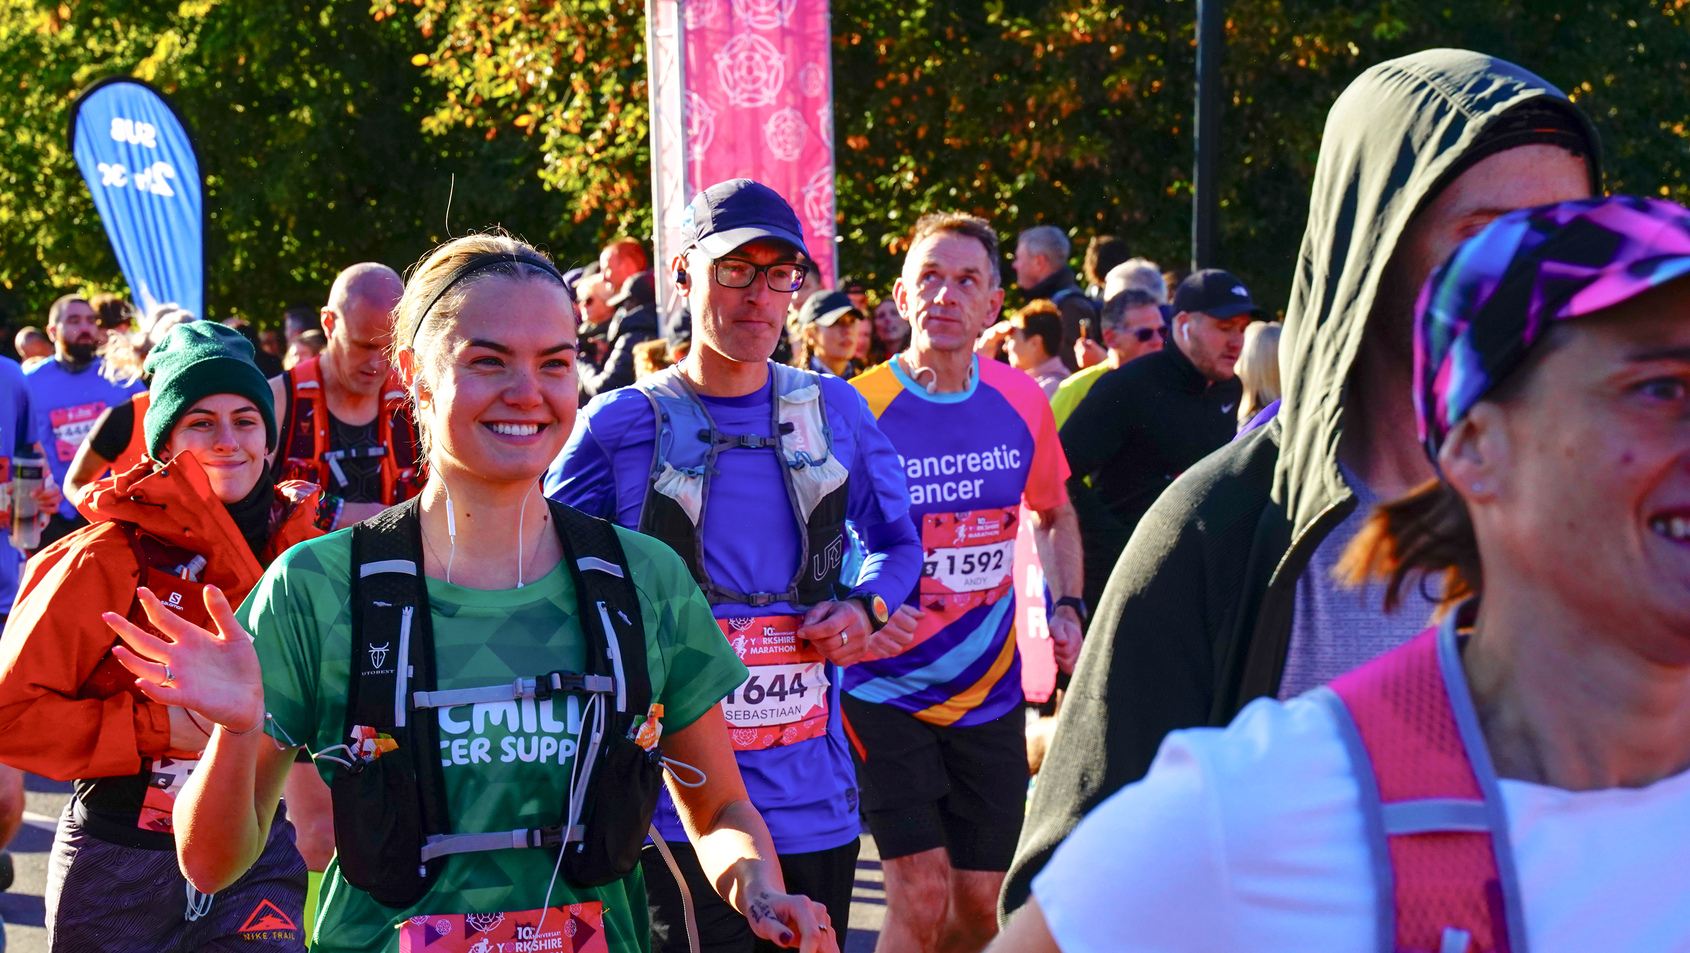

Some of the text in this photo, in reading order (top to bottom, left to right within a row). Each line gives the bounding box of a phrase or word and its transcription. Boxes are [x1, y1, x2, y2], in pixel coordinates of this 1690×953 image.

[909, 478, 984, 505] ancer
[946, 549, 1004, 576] 1592
[964, 576, 988, 587] ANDY
[160, 600, 184, 611] salomon
[750, 645, 797, 655] MARATHON
[725, 704, 802, 721] SEBASTIAAN
[243, 931, 296, 941] NIKE TRAIL
